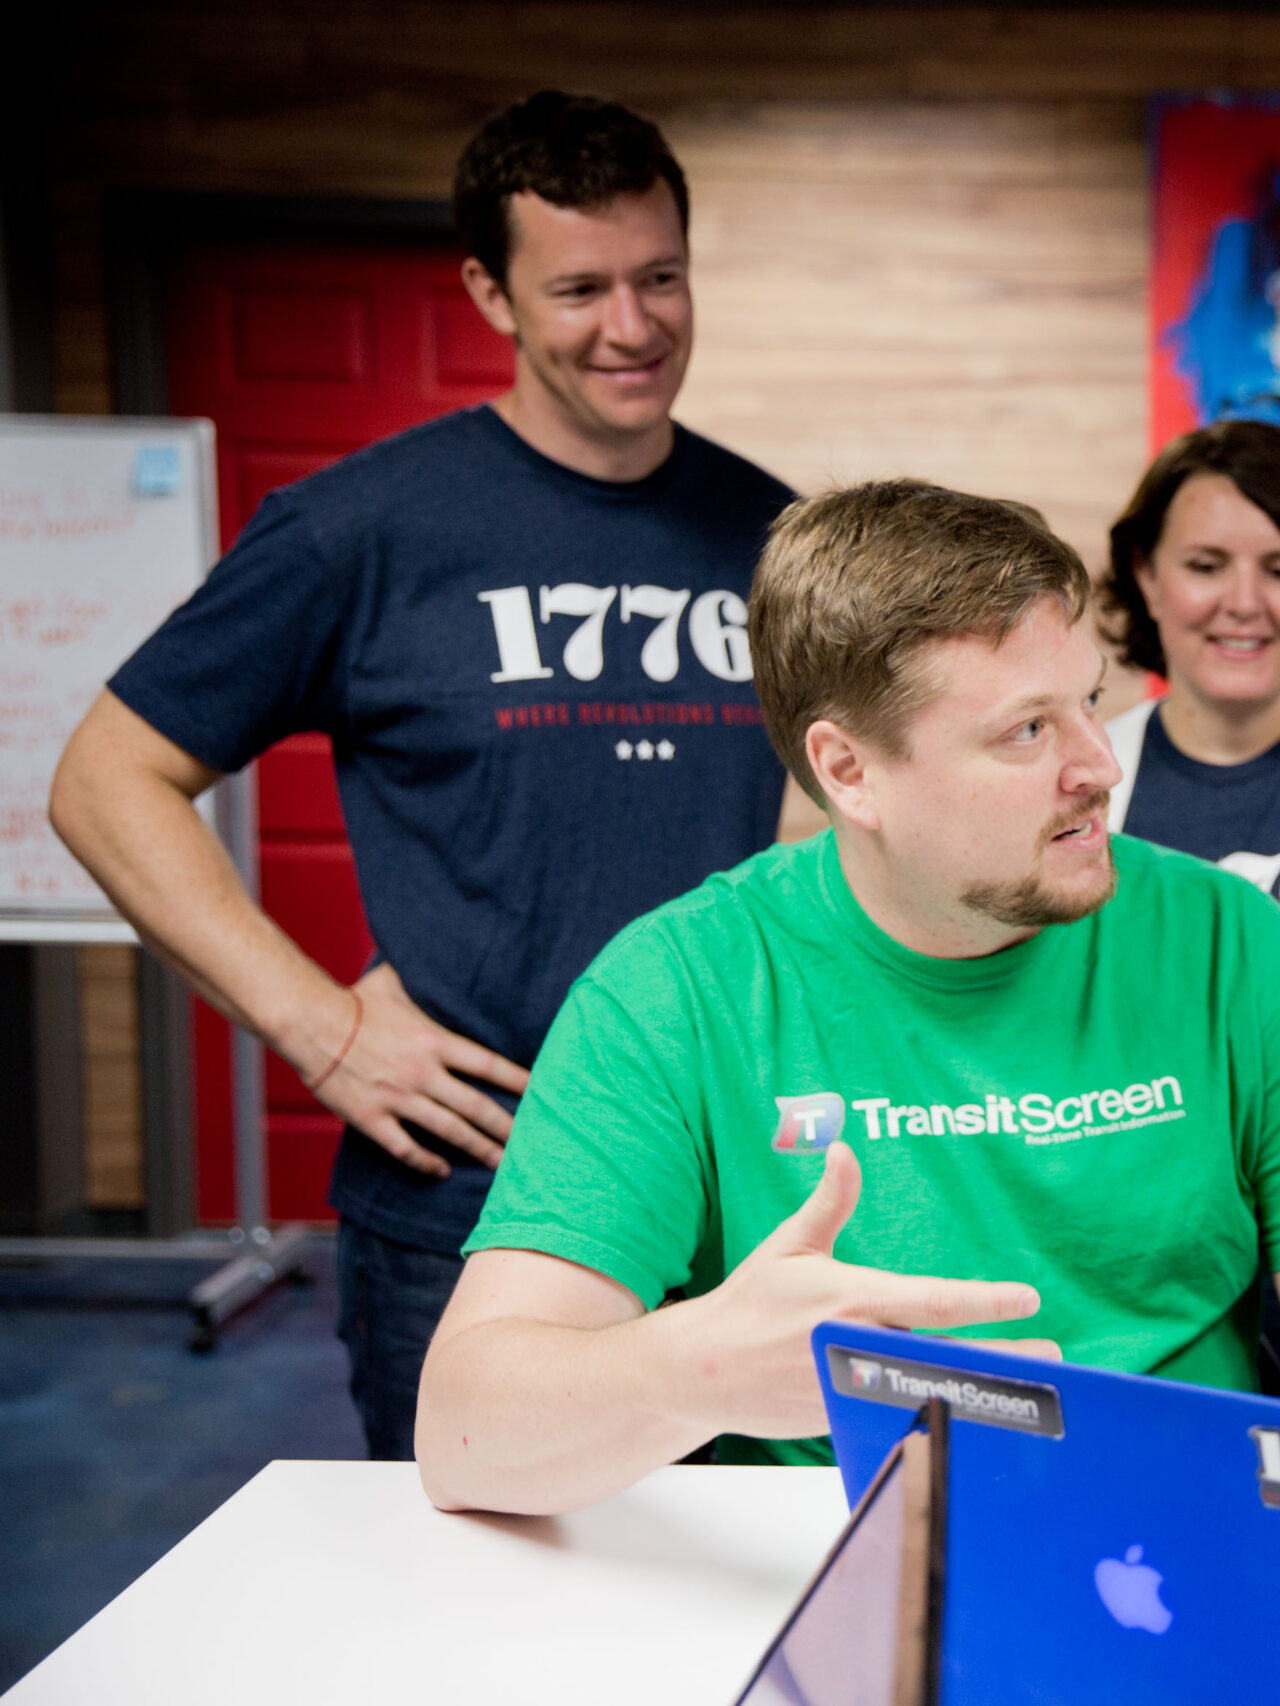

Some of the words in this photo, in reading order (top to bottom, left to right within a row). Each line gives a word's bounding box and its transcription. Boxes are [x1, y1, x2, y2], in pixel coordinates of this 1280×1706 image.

[477, 582, 754, 683] 1776
[495, 703, 570, 730] WHERE
[851, 1075, 1184, 1141] TransitScreen
[884, 1367, 1040, 1419] TransitScreen
